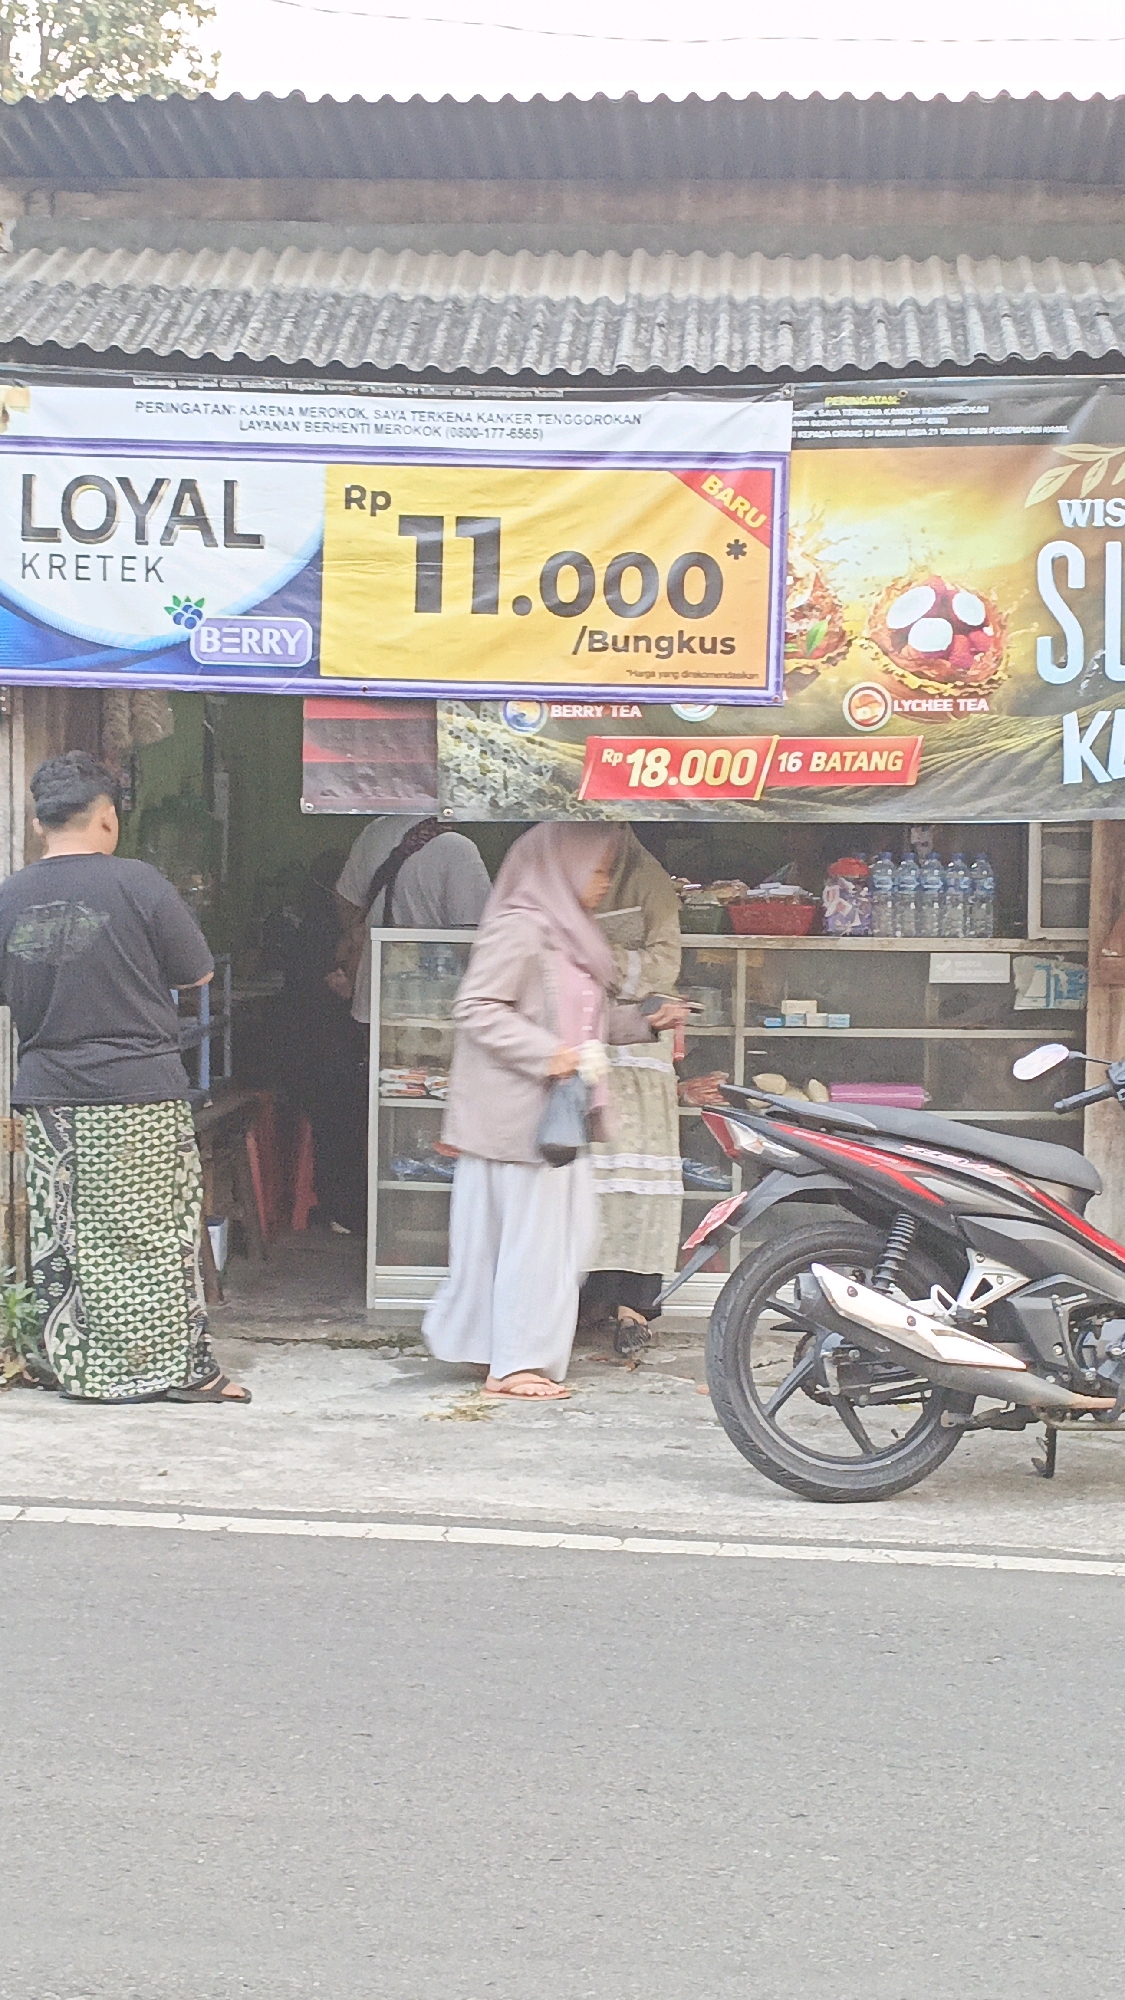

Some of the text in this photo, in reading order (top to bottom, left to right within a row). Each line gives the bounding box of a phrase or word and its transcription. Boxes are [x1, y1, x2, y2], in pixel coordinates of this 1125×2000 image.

[135, 401, 642, 425] PERINGATAN: KARENA MEROKOK, SAYA TERKENA KANKER TENGGOROKAN
[240, 419, 300, 432] LAYANAN
[304, 421, 371, 434] BERHENTI
[374, 423, 442, 437] MEROKOK
[21, 473, 265, 549] LOYAL
[344, 484, 392, 516] Rp
[700, 474, 767, 528] BARU
[21, 552, 164, 584] KRETEK
[200, 627, 304, 656] BERRY
[572, 625, 736, 659] /Bungkus
[550, 704, 643, 718] BERRY TEA
[893, 698, 989, 712] LYCHEE TEA
[601, 748, 758, 787] Rp 18.000
[777, 750, 904, 773] 16 BATANG
